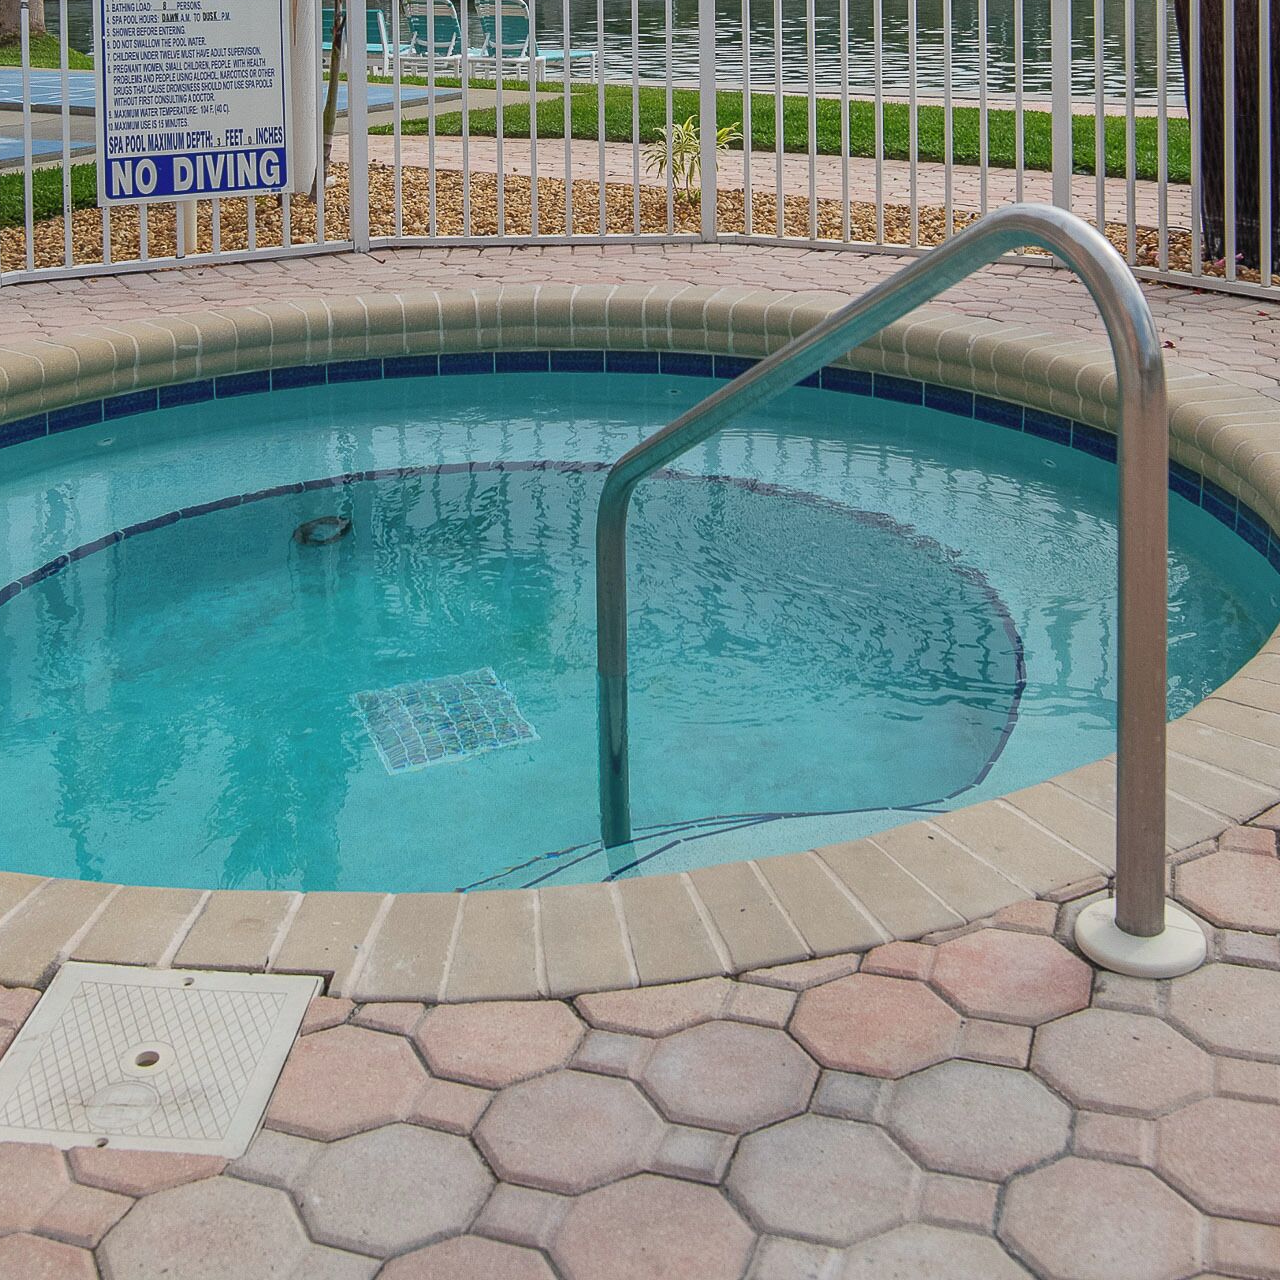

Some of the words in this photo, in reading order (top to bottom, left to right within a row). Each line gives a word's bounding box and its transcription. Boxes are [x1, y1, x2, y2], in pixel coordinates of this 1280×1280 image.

[112, 4, 135, 12] BATHING
[112, 16, 122, 24] SPA
[124, 15, 137, 23] POOL
[139, 15, 159, 23] HOURS:
[162, 12, 179, 22] DAWN
[194, 13, 200, 22] TO
[203, 11, 217, 21] DUSK
[112, 28, 135, 37] SHOWER
[137, 27, 157, 36] BEFORE
[113, 40, 120, 49] DO
[121, 40, 132, 48] NOT
[134, 39, 160, 48] SWALLOW
[162, 38, 171, 47] THE
[173, 38, 186, 46] POOL
[113, 52, 139, 61] CHILDREN
[141, 51, 158, 60] UNDER
[160, 50, 180, 59] TWELVE
[181, 50, 195, 58] MUST
[197, 49, 210, 58] HAVE
[211, 48, 227, 57] ADULT
[113, 64, 142, 73] PREGNANT
[166, 62, 182, 71] SMALL
[211, 60, 231, 69] PEOPLE
[233, 59, 245, 68] WITH
[247, 58, 265, 67] HEALTH
[114, 75, 142, 84] PROBLEMS
[143, 74, 154, 83] AND
[155, 73, 175, 82] PEOPLE
[177, 72, 193, 81] USING
[220, 70, 248, 79] NARCOTICS
[250, 69, 257, 78] OR
[258, 68, 275, 77] OTHER
[114, 86, 132, 95] DRUGS
[133, 85, 146, 94] THAT
[148, 84, 165, 93] CAUSE
[167, 83, 200, 92] DROWSINESS
[202, 82, 221, 91] SHOULD
[223, 81, 233, 90] NOT
[234, 81, 244, 89] USE
[245, 80, 255, 89] SPA
[256, 79, 272, 88] POOLS
[114, 97, 137, 106] WITHOUT
[139, 96, 153, 105] FIRST
[155, 95, 187, 104] CONSULTING
[188, 94, 192, 103] A
[114, 109, 139, 118] MAXIMUM
[140, 108, 158, 117] WATER
[115, 122, 139, 130] MAXIMUM
[140, 121, 151, 129] USE
[152, 121, 157, 129] IS
[158, 120, 163, 128] 15
[109, 137, 123, 153] SPA
[125, 135, 146, 152] POOL
[148, 132, 184, 151] MAXIMUM
[186, 131, 213, 148] DEPTH:
[225, 129, 243, 146] FEET
[248, 136, 252, 144] 0
[256, 126, 282, 144] INCHES
[112, 158, 157, 195] NO
[173, 151, 280, 192] DIVING
